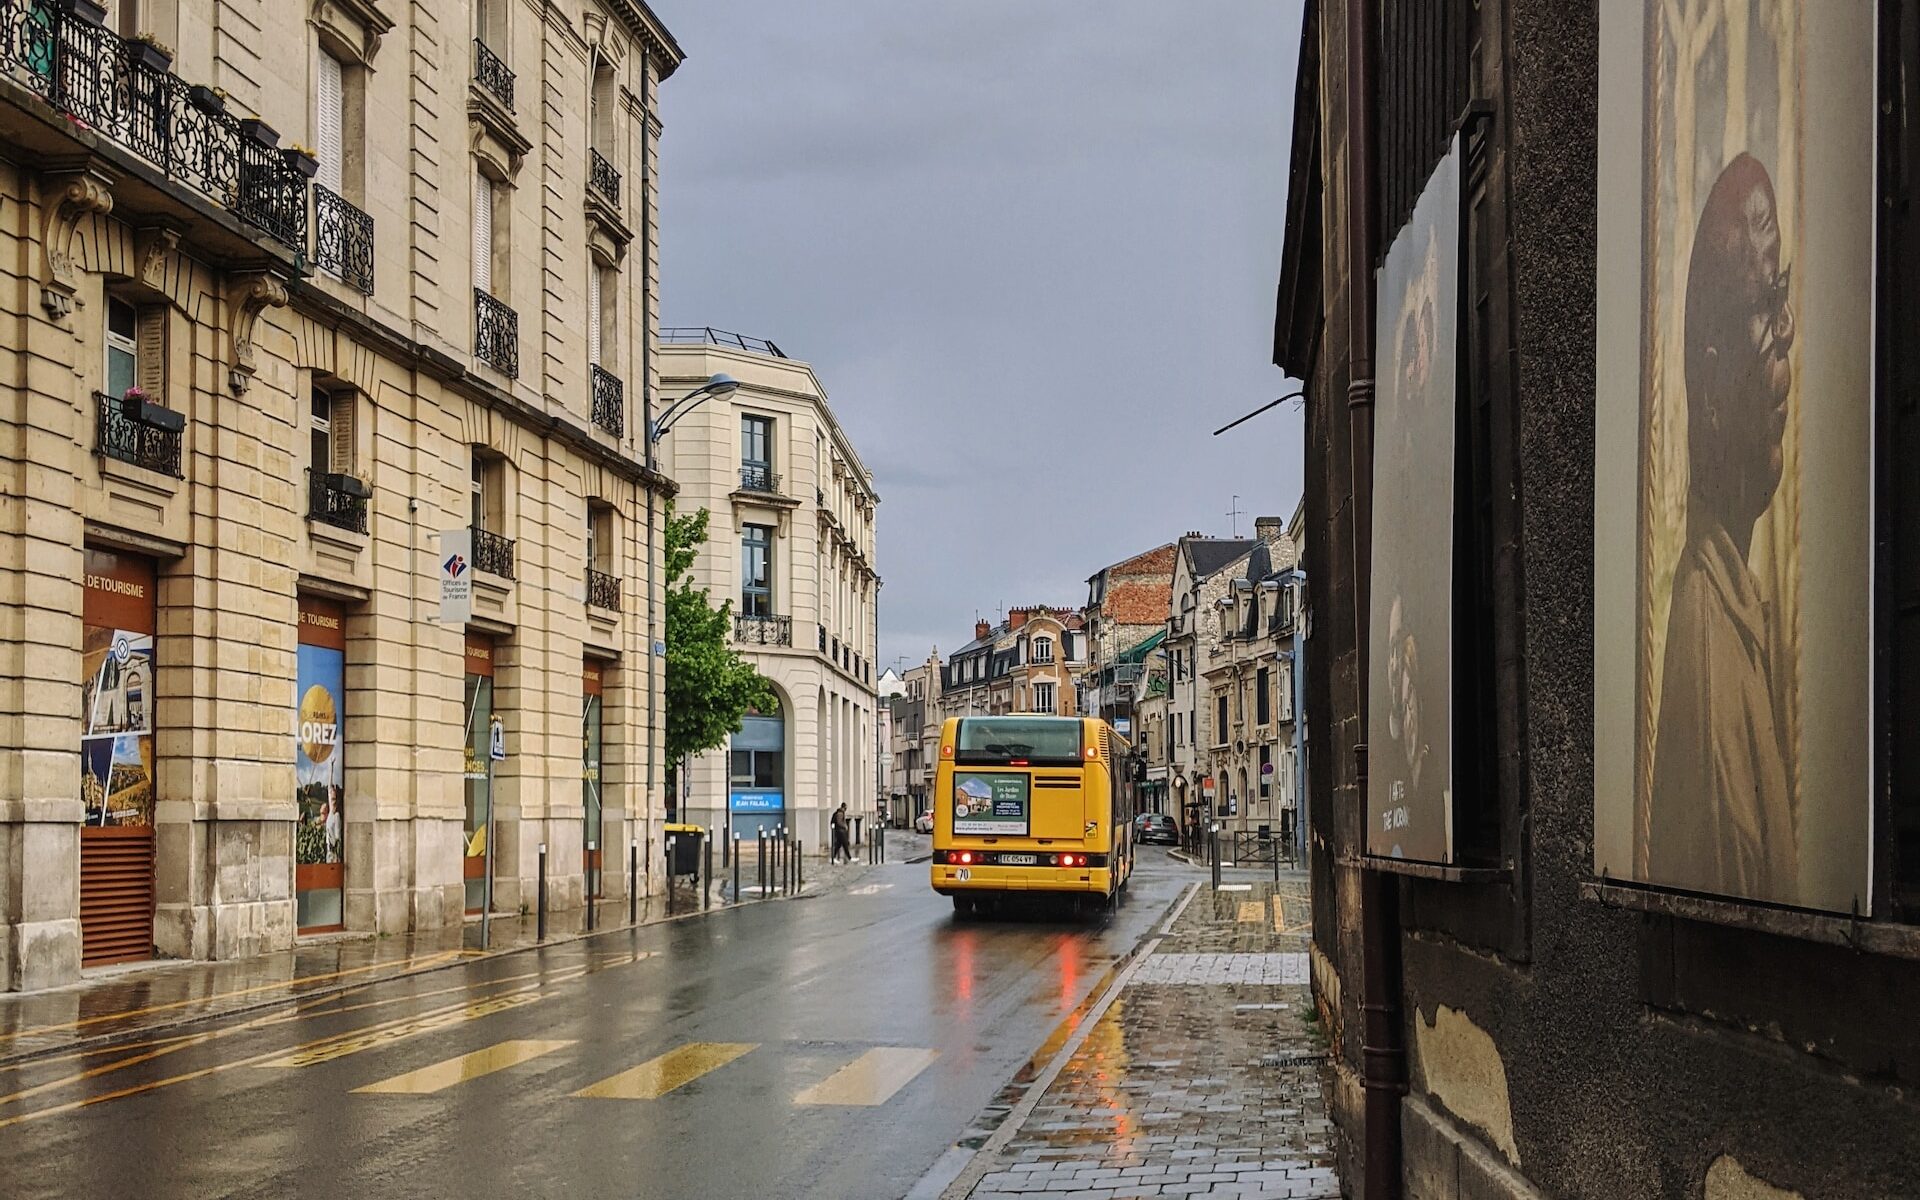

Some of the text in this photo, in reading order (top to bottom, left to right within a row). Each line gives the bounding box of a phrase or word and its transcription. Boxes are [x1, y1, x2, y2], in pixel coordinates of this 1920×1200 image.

[87, 574, 100, 589] DE
[100, 577, 144, 598] TOURISME
[307, 613, 339, 630] TOURISME
[959, 868, 969, 880] 70
